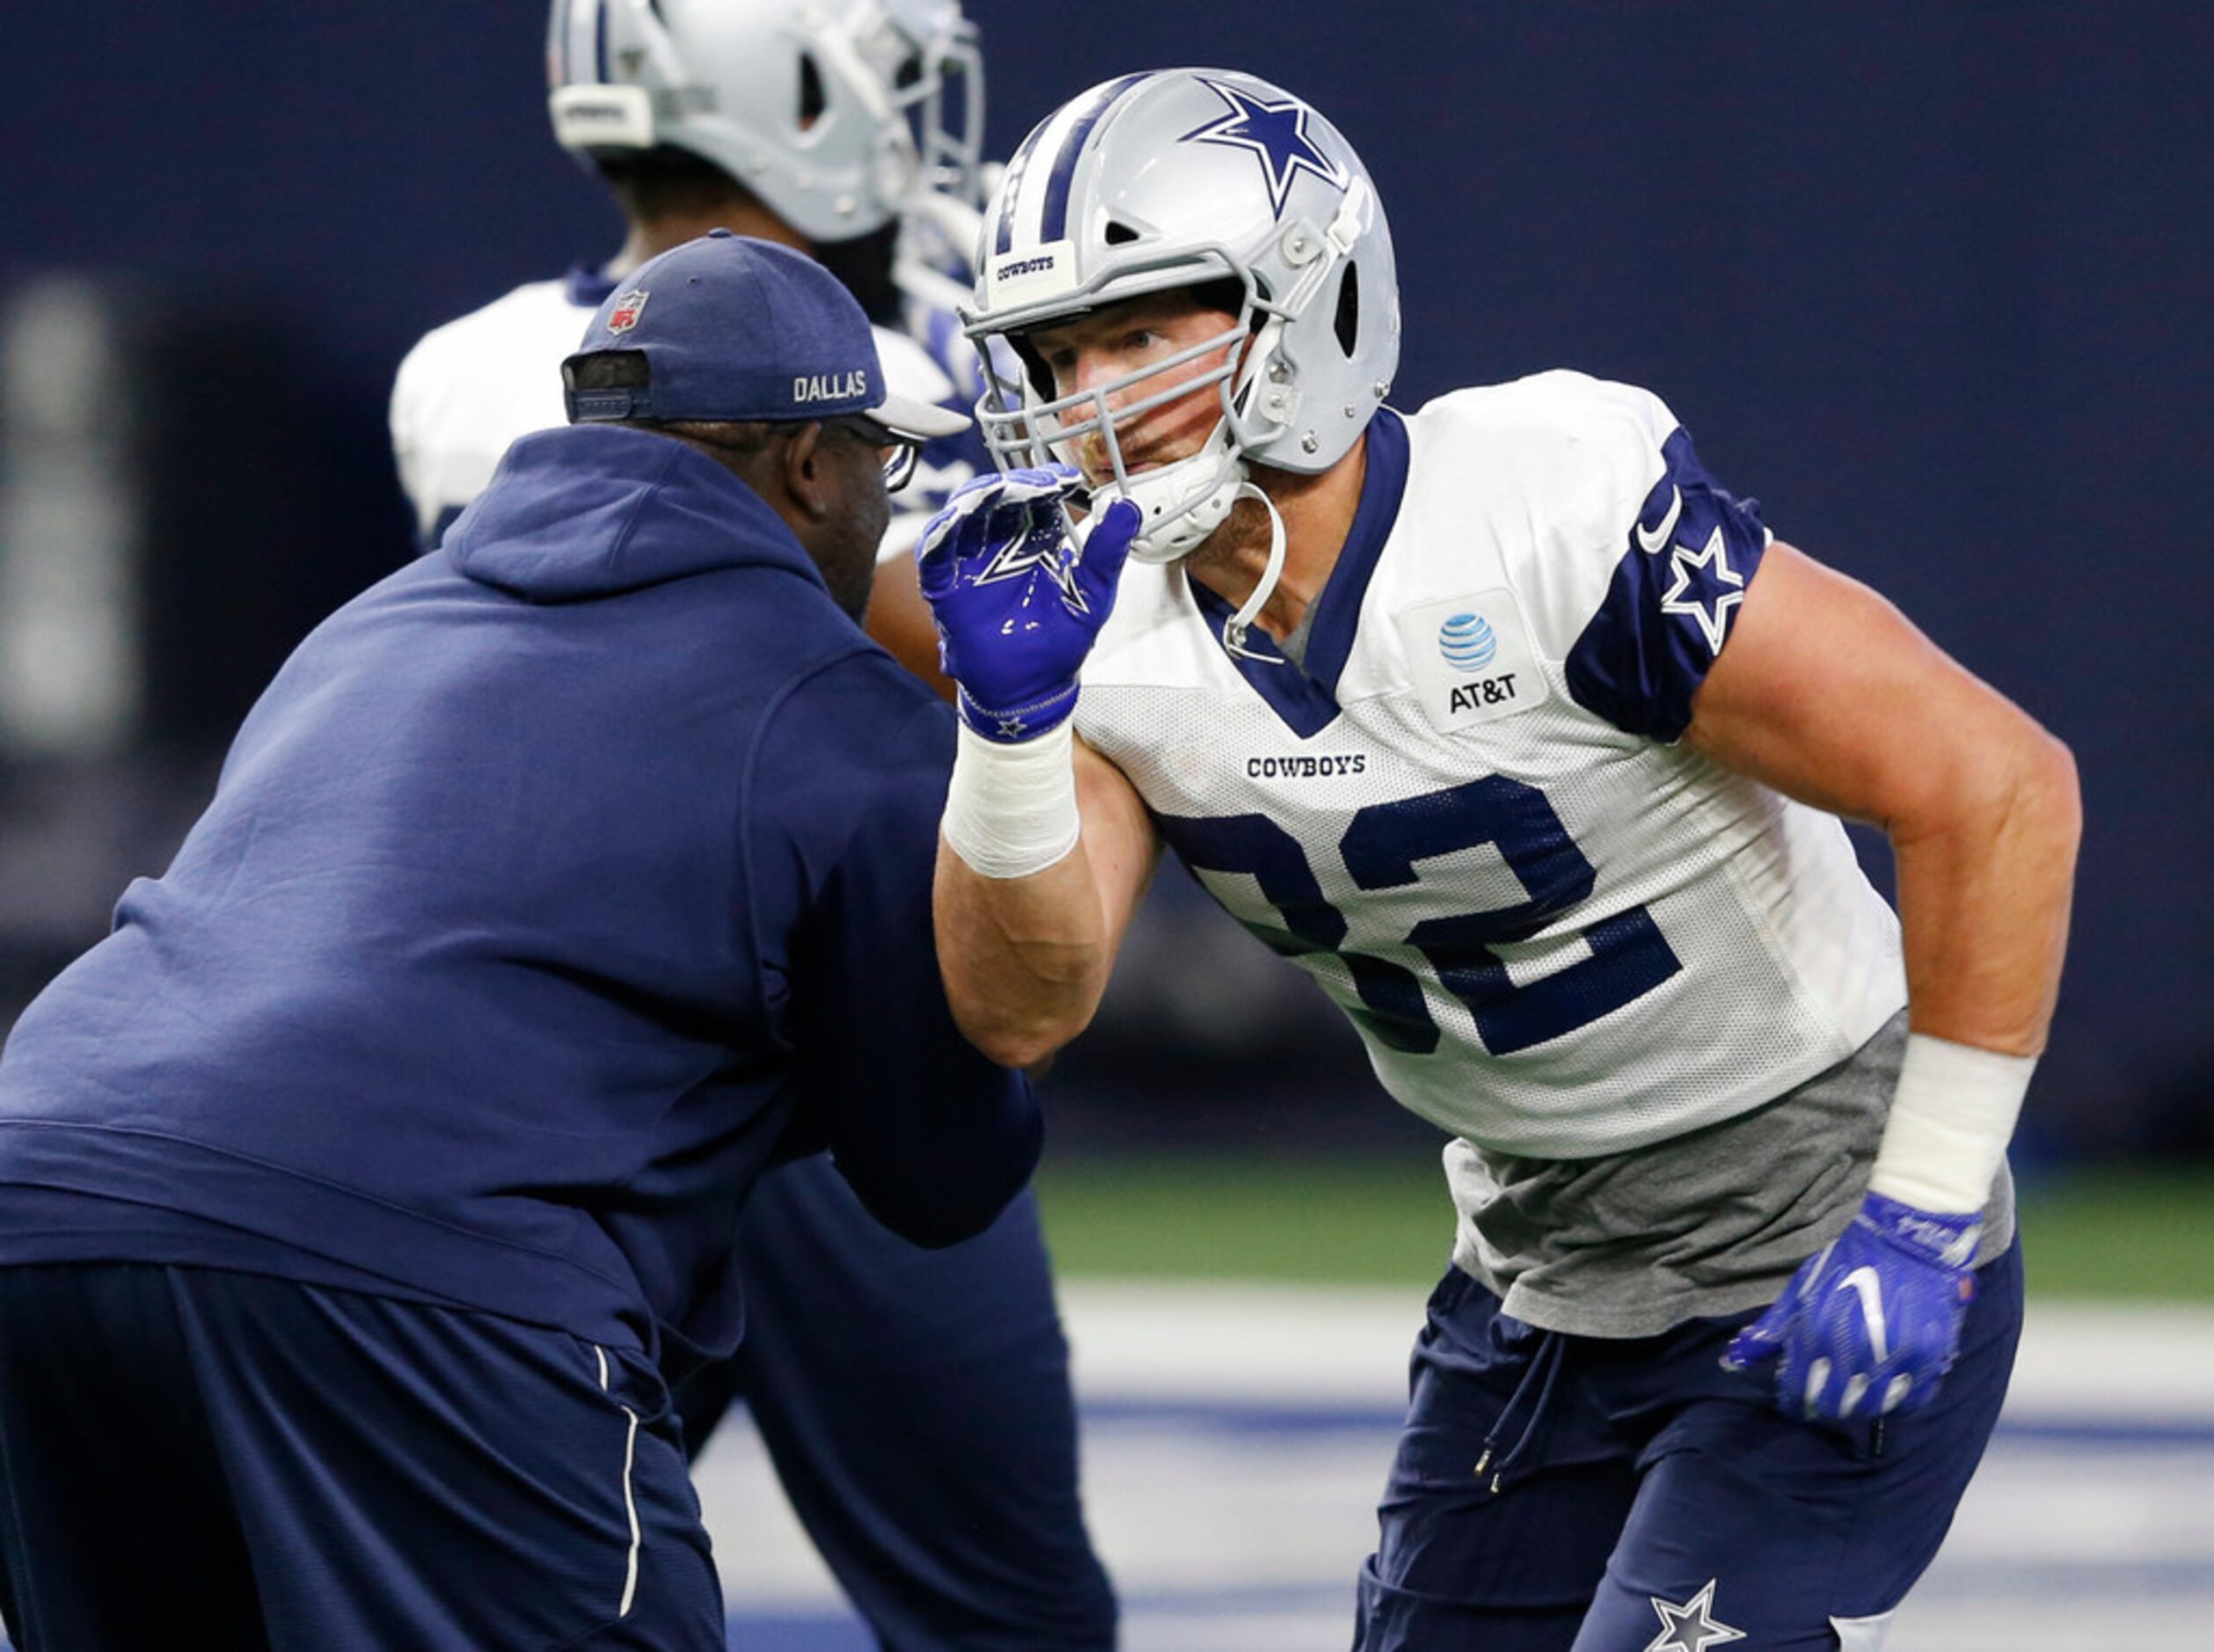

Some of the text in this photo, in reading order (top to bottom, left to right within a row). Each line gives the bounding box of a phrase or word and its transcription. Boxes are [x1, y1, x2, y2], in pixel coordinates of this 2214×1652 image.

[997, 256, 1054, 281] COWBOYS
[794, 369, 866, 402] DALLAS
[1450, 673, 1516, 714] AT&T
[1246, 754, 1366, 778] COWBOYS
